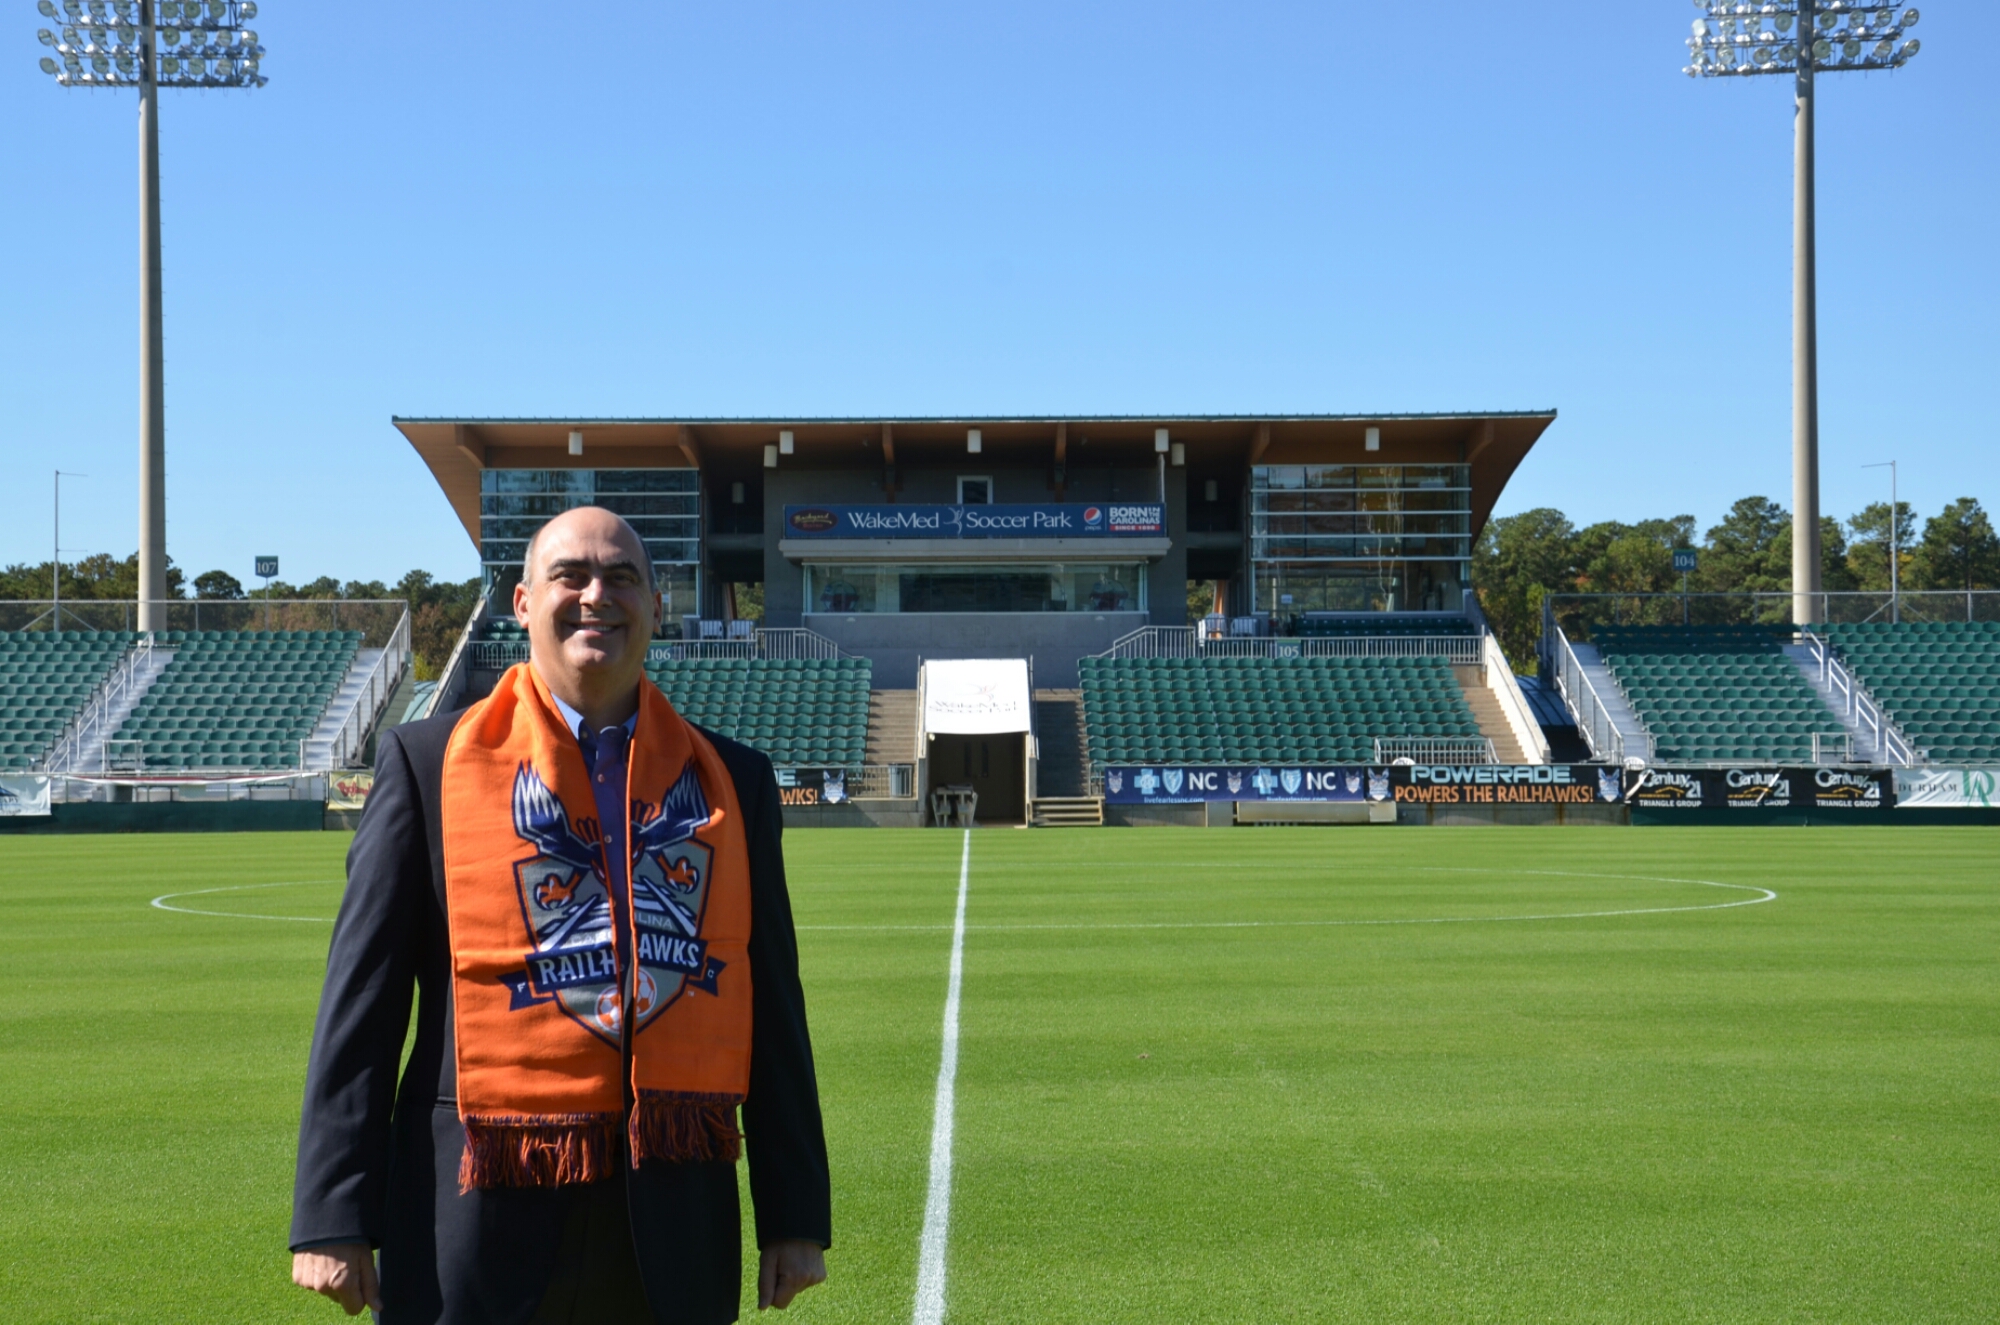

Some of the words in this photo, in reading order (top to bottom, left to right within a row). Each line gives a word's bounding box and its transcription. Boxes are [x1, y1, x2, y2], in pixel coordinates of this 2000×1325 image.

[1109, 507, 1147, 517] BORN
[848, 511, 940, 529] WakeMed
[966, 511, 1030, 529] Soccer
[1033, 511, 1073, 528] Park
[1109, 517, 1160, 525] CAROLINAS
[1675, 555, 1695, 567] 104
[257, 562, 277, 574] 107
[650, 648, 671, 660] 106
[1280, 646, 1300, 659] 105
[1189, 772, 1218, 790] NC
[1306, 771, 1336, 790] NC
[1815, 769, 1869, 788] Century
[1864, 781, 1880, 798] 21
[1395, 785, 1459, 802] POWERS
[1463, 785, 1493, 802] THE
[1497, 785, 1593, 802] RAILHAWKS!
[1686, 780, 1702, 798] 21
[1773, 779, 1790, 797] 21
[1898, 783, 1958, 792] DURHAM
[1676, 800, 1702, 808] GROUP
[707, 969, 715, 979] C
[517, 981, 526, 993] F
